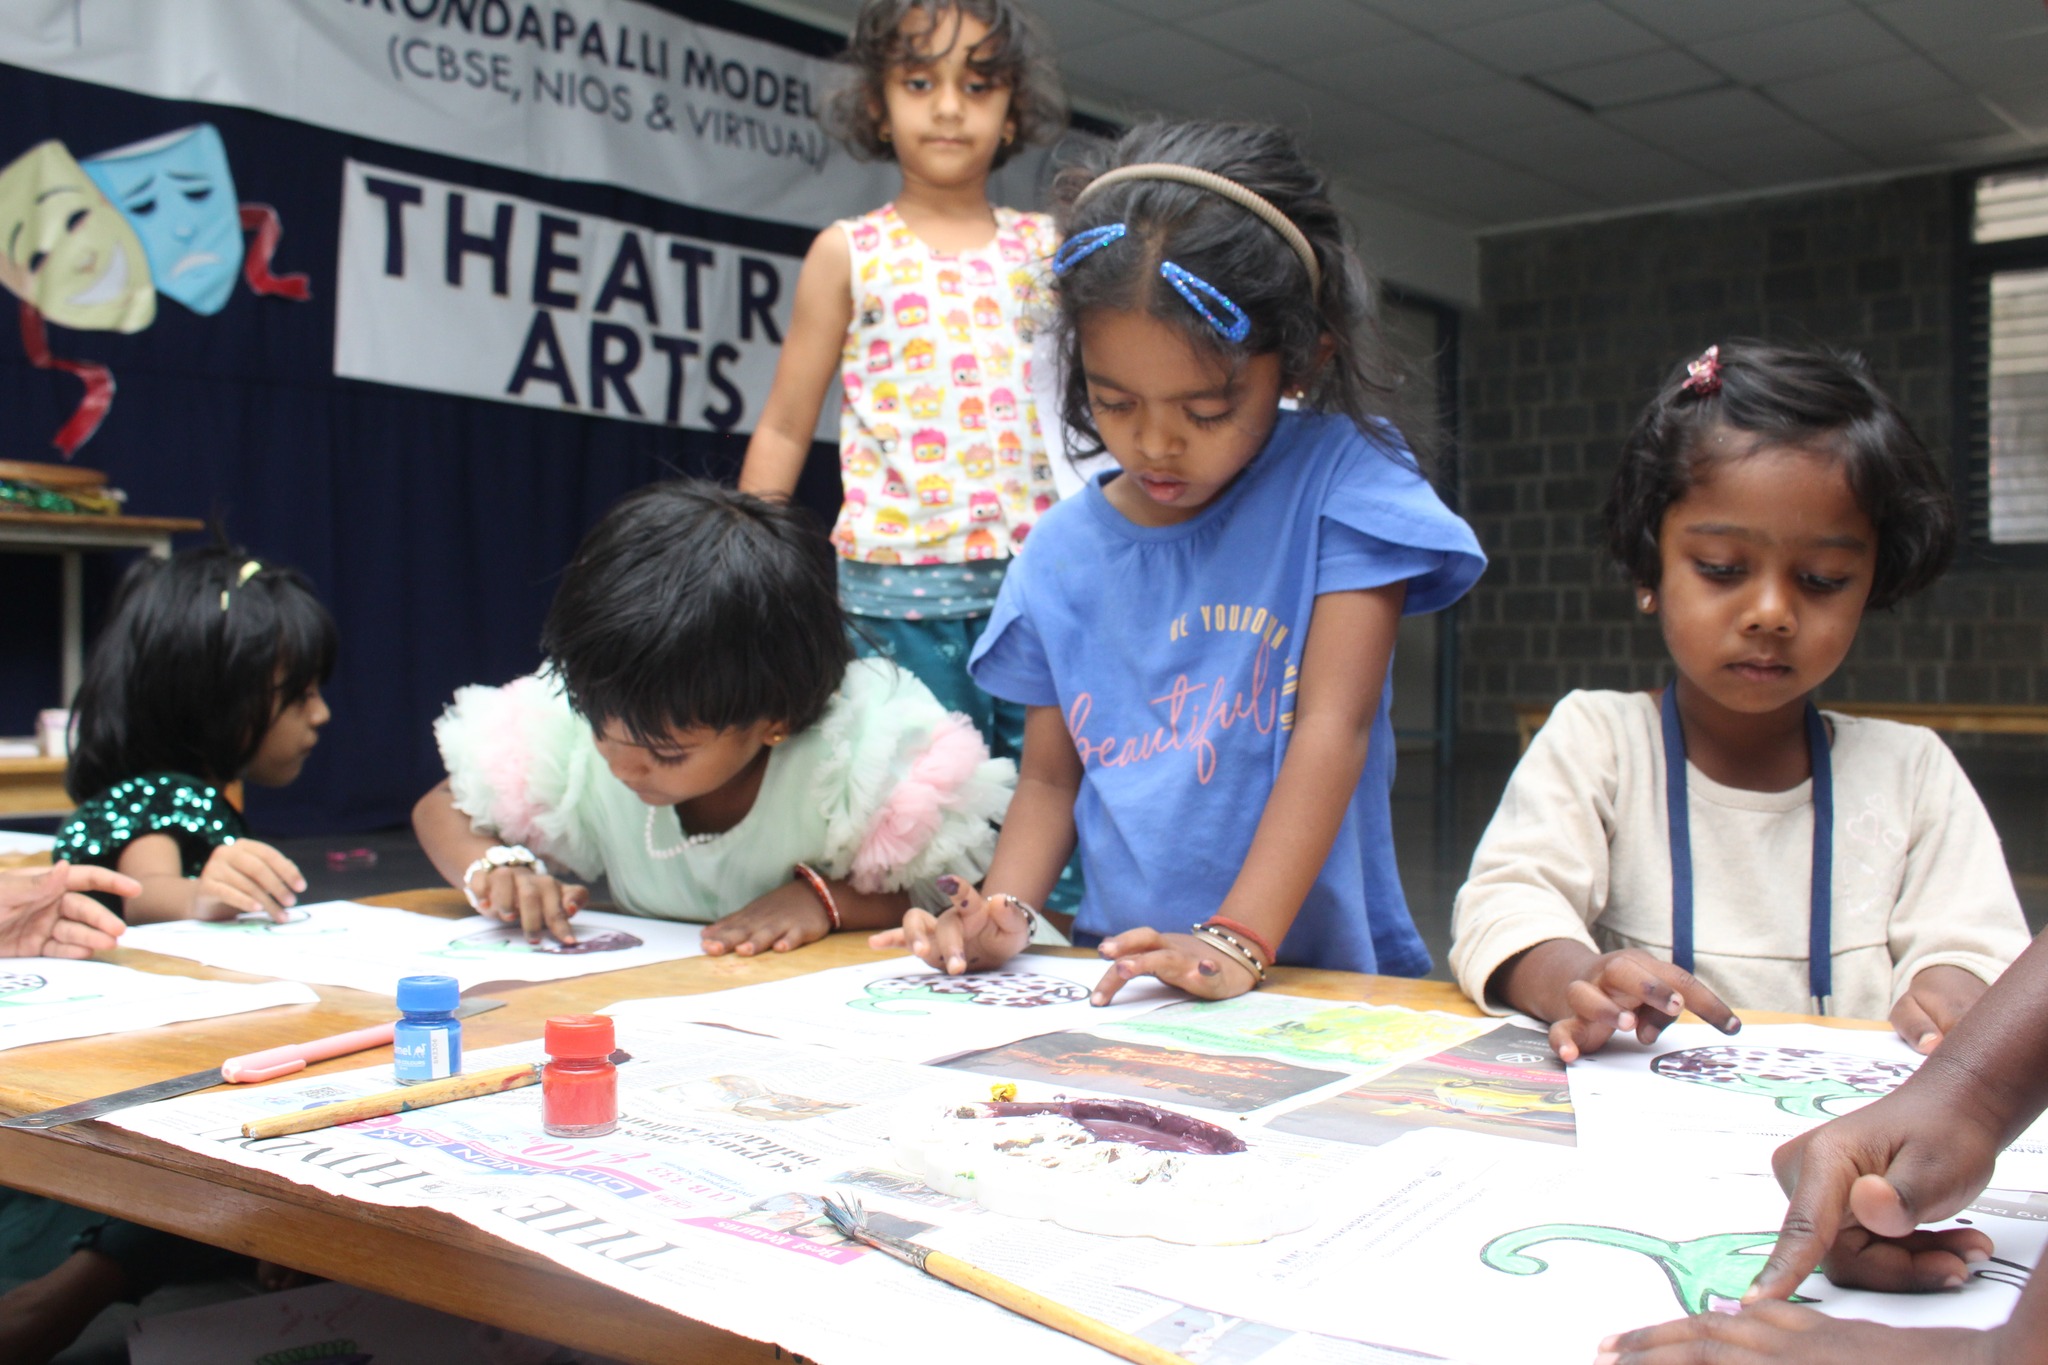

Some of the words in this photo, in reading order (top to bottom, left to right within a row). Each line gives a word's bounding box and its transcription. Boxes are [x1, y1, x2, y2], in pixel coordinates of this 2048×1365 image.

[346, 0, 670, 79] ONDAPALLI
[684, 48, 821, 119] MODEL
[389, 35, 521, 104] (CBSE,
[534, 66, 633, 123] NIOS
[644, 92, 676, 135] &
[364, 175, 785, 346] THEATR
[505, 309, 745, 432] ARTS
[1068, 637, 1277, 785] beautiful
[368, 1129, 436, 1148] ANK
[552, 1168, 635, 1194] CITY
[490, 1195, 689, 1272] THE
[713, 1220, 793, 1246] Returns
[790, 1242, 842, 1259] Best
